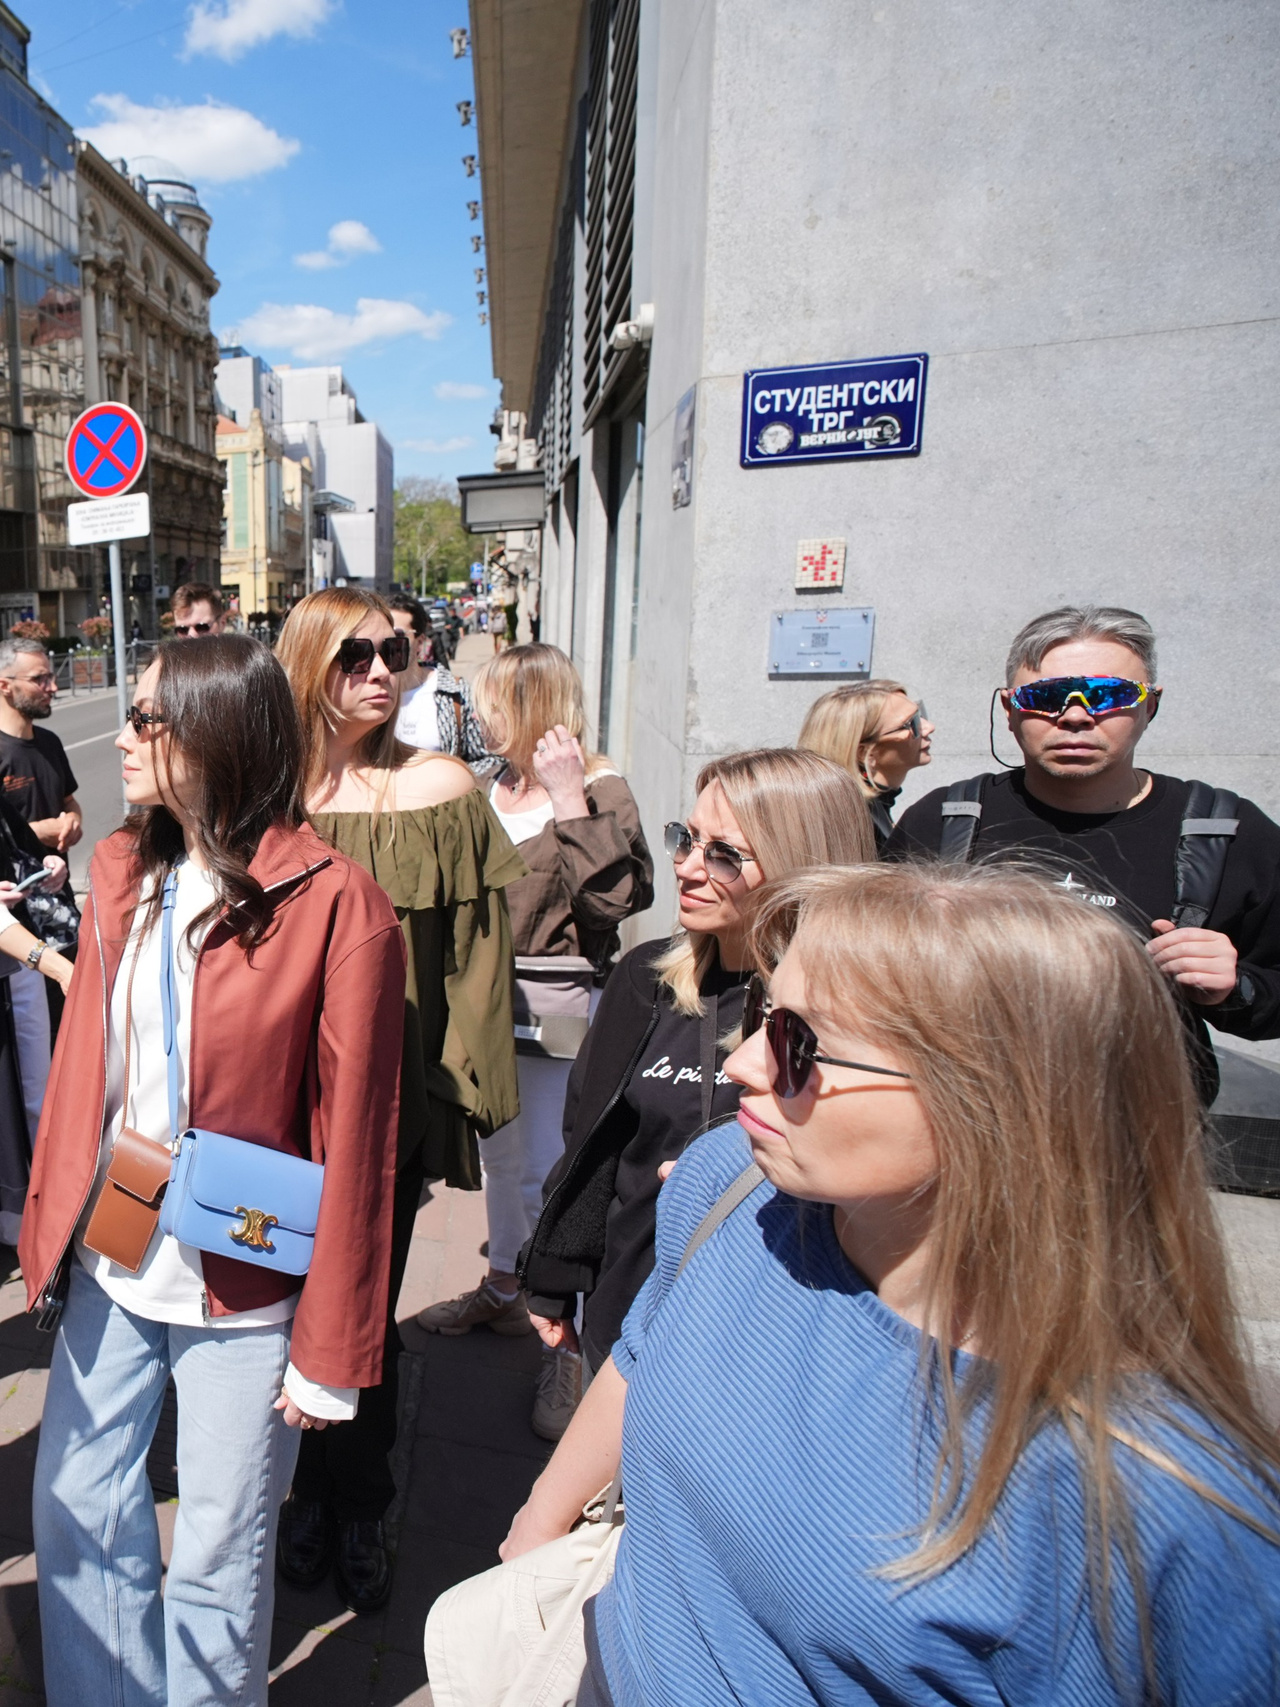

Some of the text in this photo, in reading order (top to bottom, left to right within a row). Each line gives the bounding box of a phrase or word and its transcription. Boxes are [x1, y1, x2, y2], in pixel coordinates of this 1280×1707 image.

[753, 377, 916, 417] СТУДЕНТСКИ
[808, 410, 855, 432] ТРГ
[642, 1056, 674, 1078] Le
